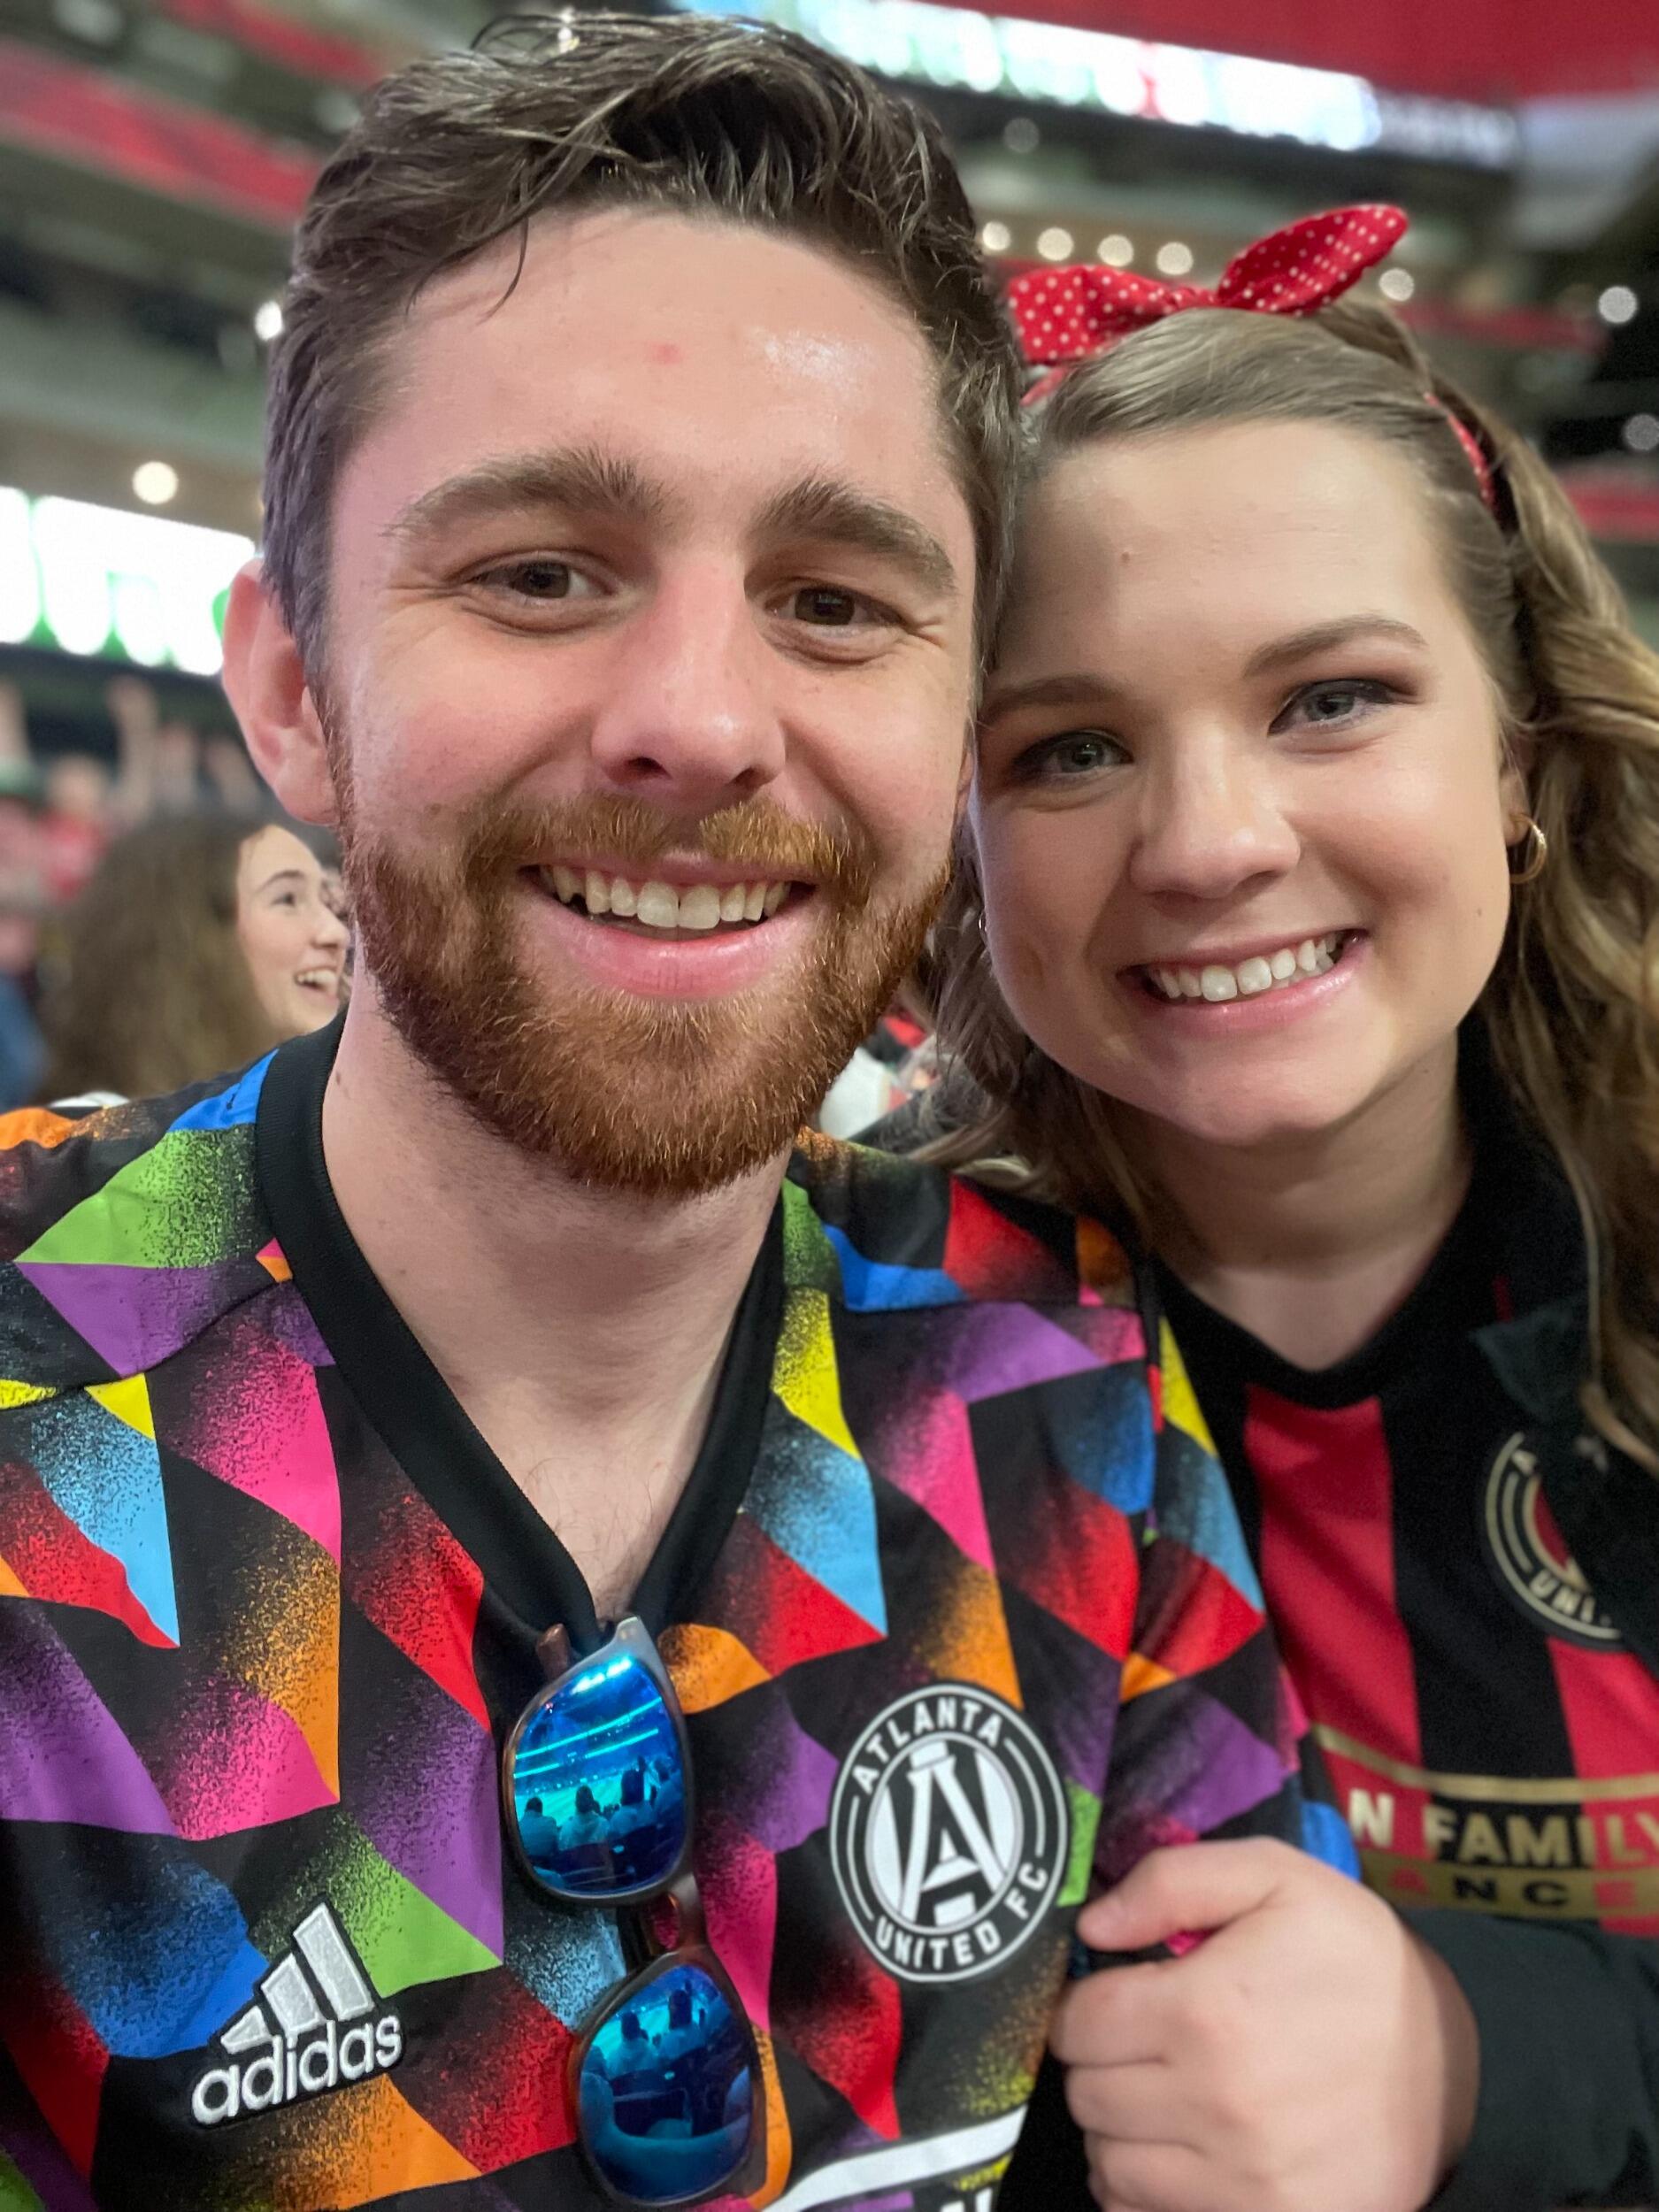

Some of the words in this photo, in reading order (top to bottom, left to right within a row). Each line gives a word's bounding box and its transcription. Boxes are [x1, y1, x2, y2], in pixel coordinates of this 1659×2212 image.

[1529, 1569, 1612, 1626] UNI
[852, 1696, 1004, 1794] ATLANTA
[875, 1916, 1002, 1970] UNITED
[1003, 1862, 1049, 1920] FC
[191, 2014, 403, 2124] adidas
